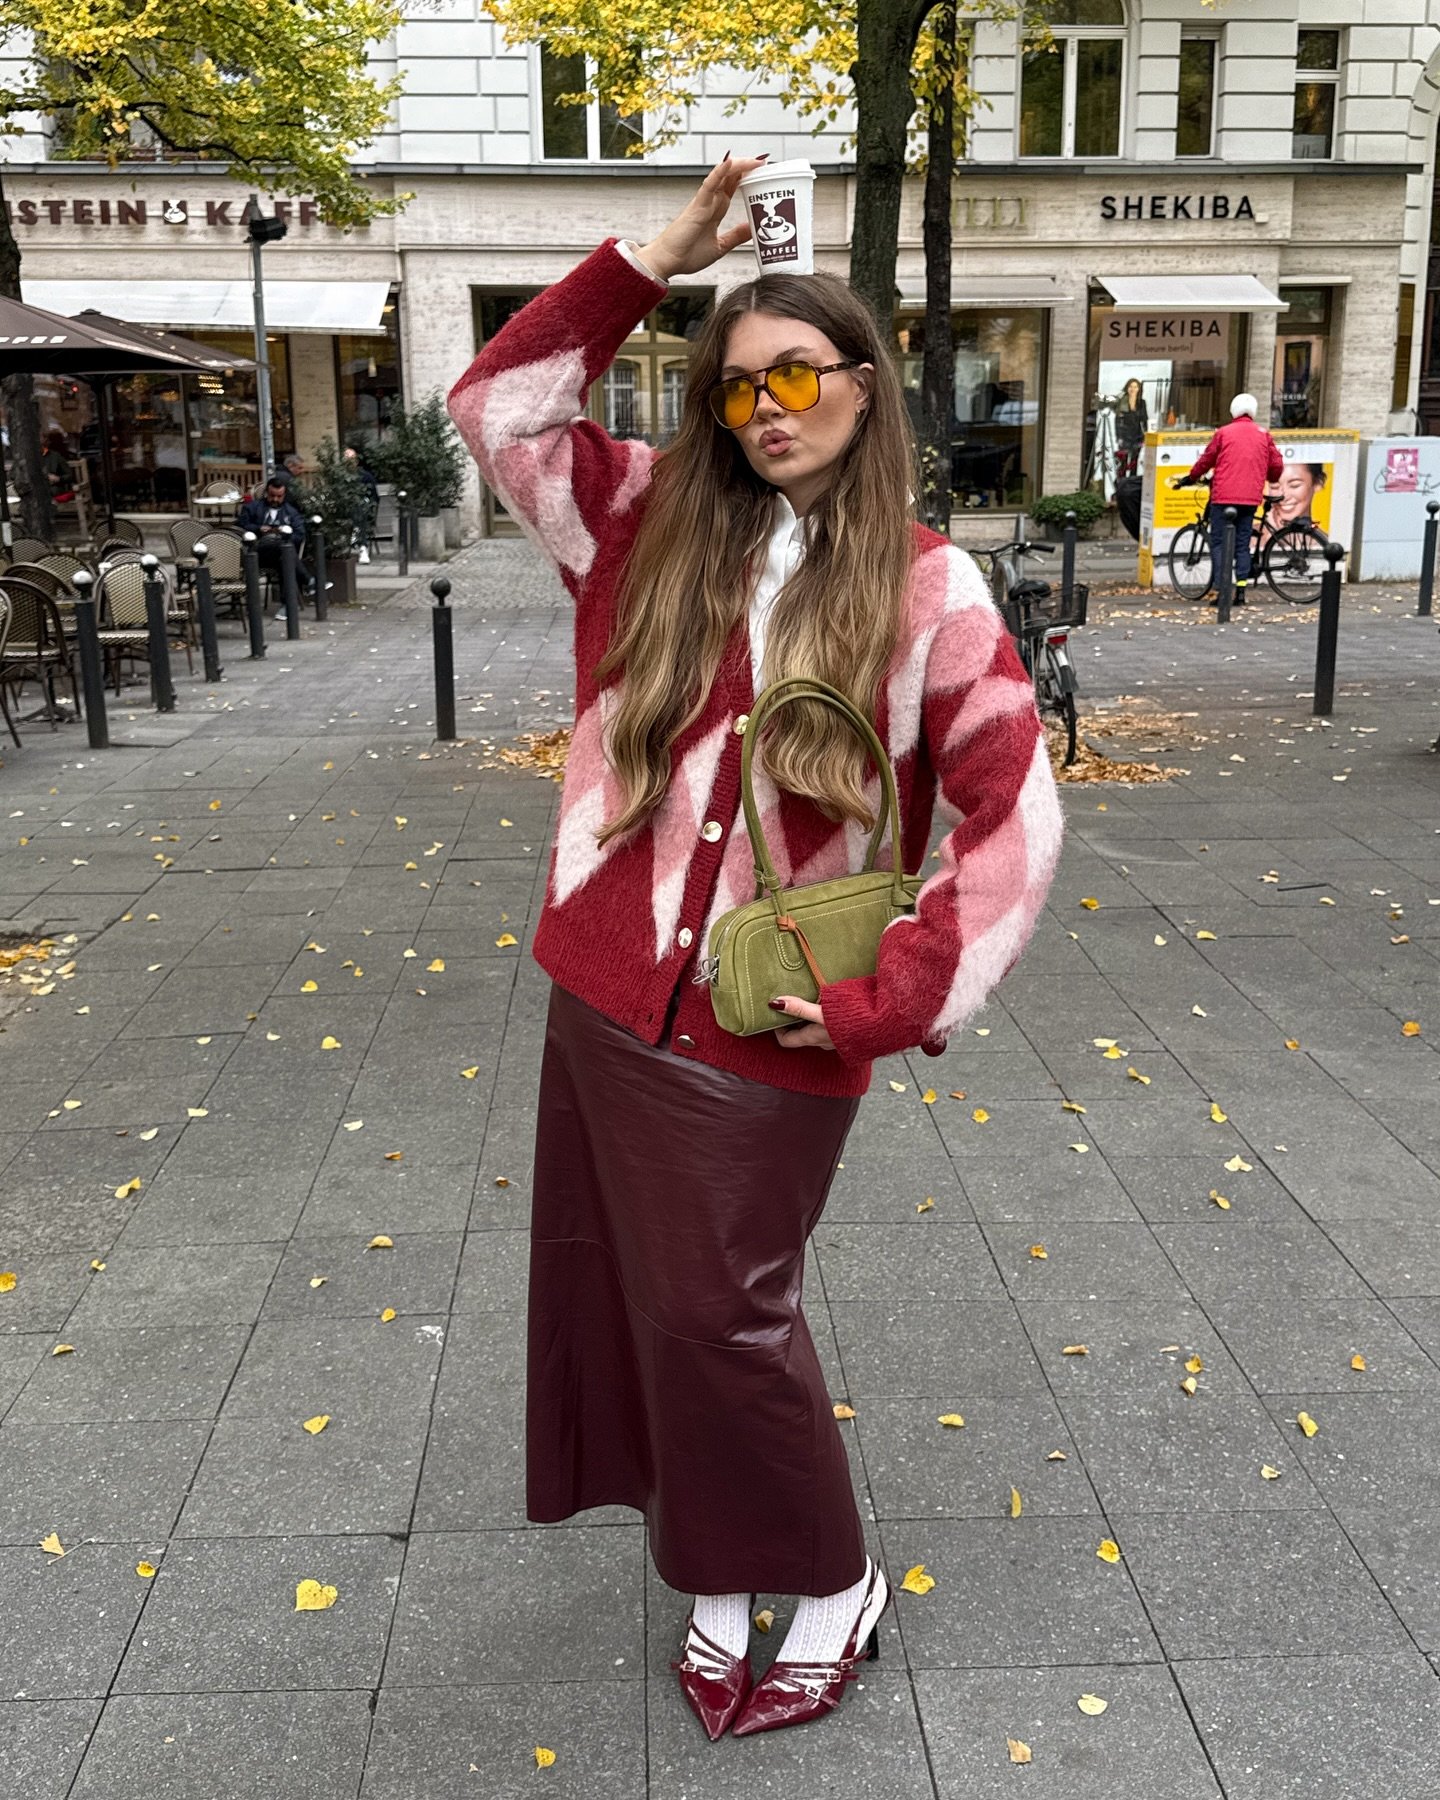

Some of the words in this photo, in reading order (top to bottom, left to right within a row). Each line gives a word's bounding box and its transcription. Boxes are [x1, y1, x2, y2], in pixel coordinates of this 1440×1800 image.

[748, 189, 796, 203] EINSTEIN
[1100, 195, 1255, 220] SHEKIBA
[760, 245, 797, 257] KAFFEE
[1109, 320, 1221, 338] SHEKIBA
